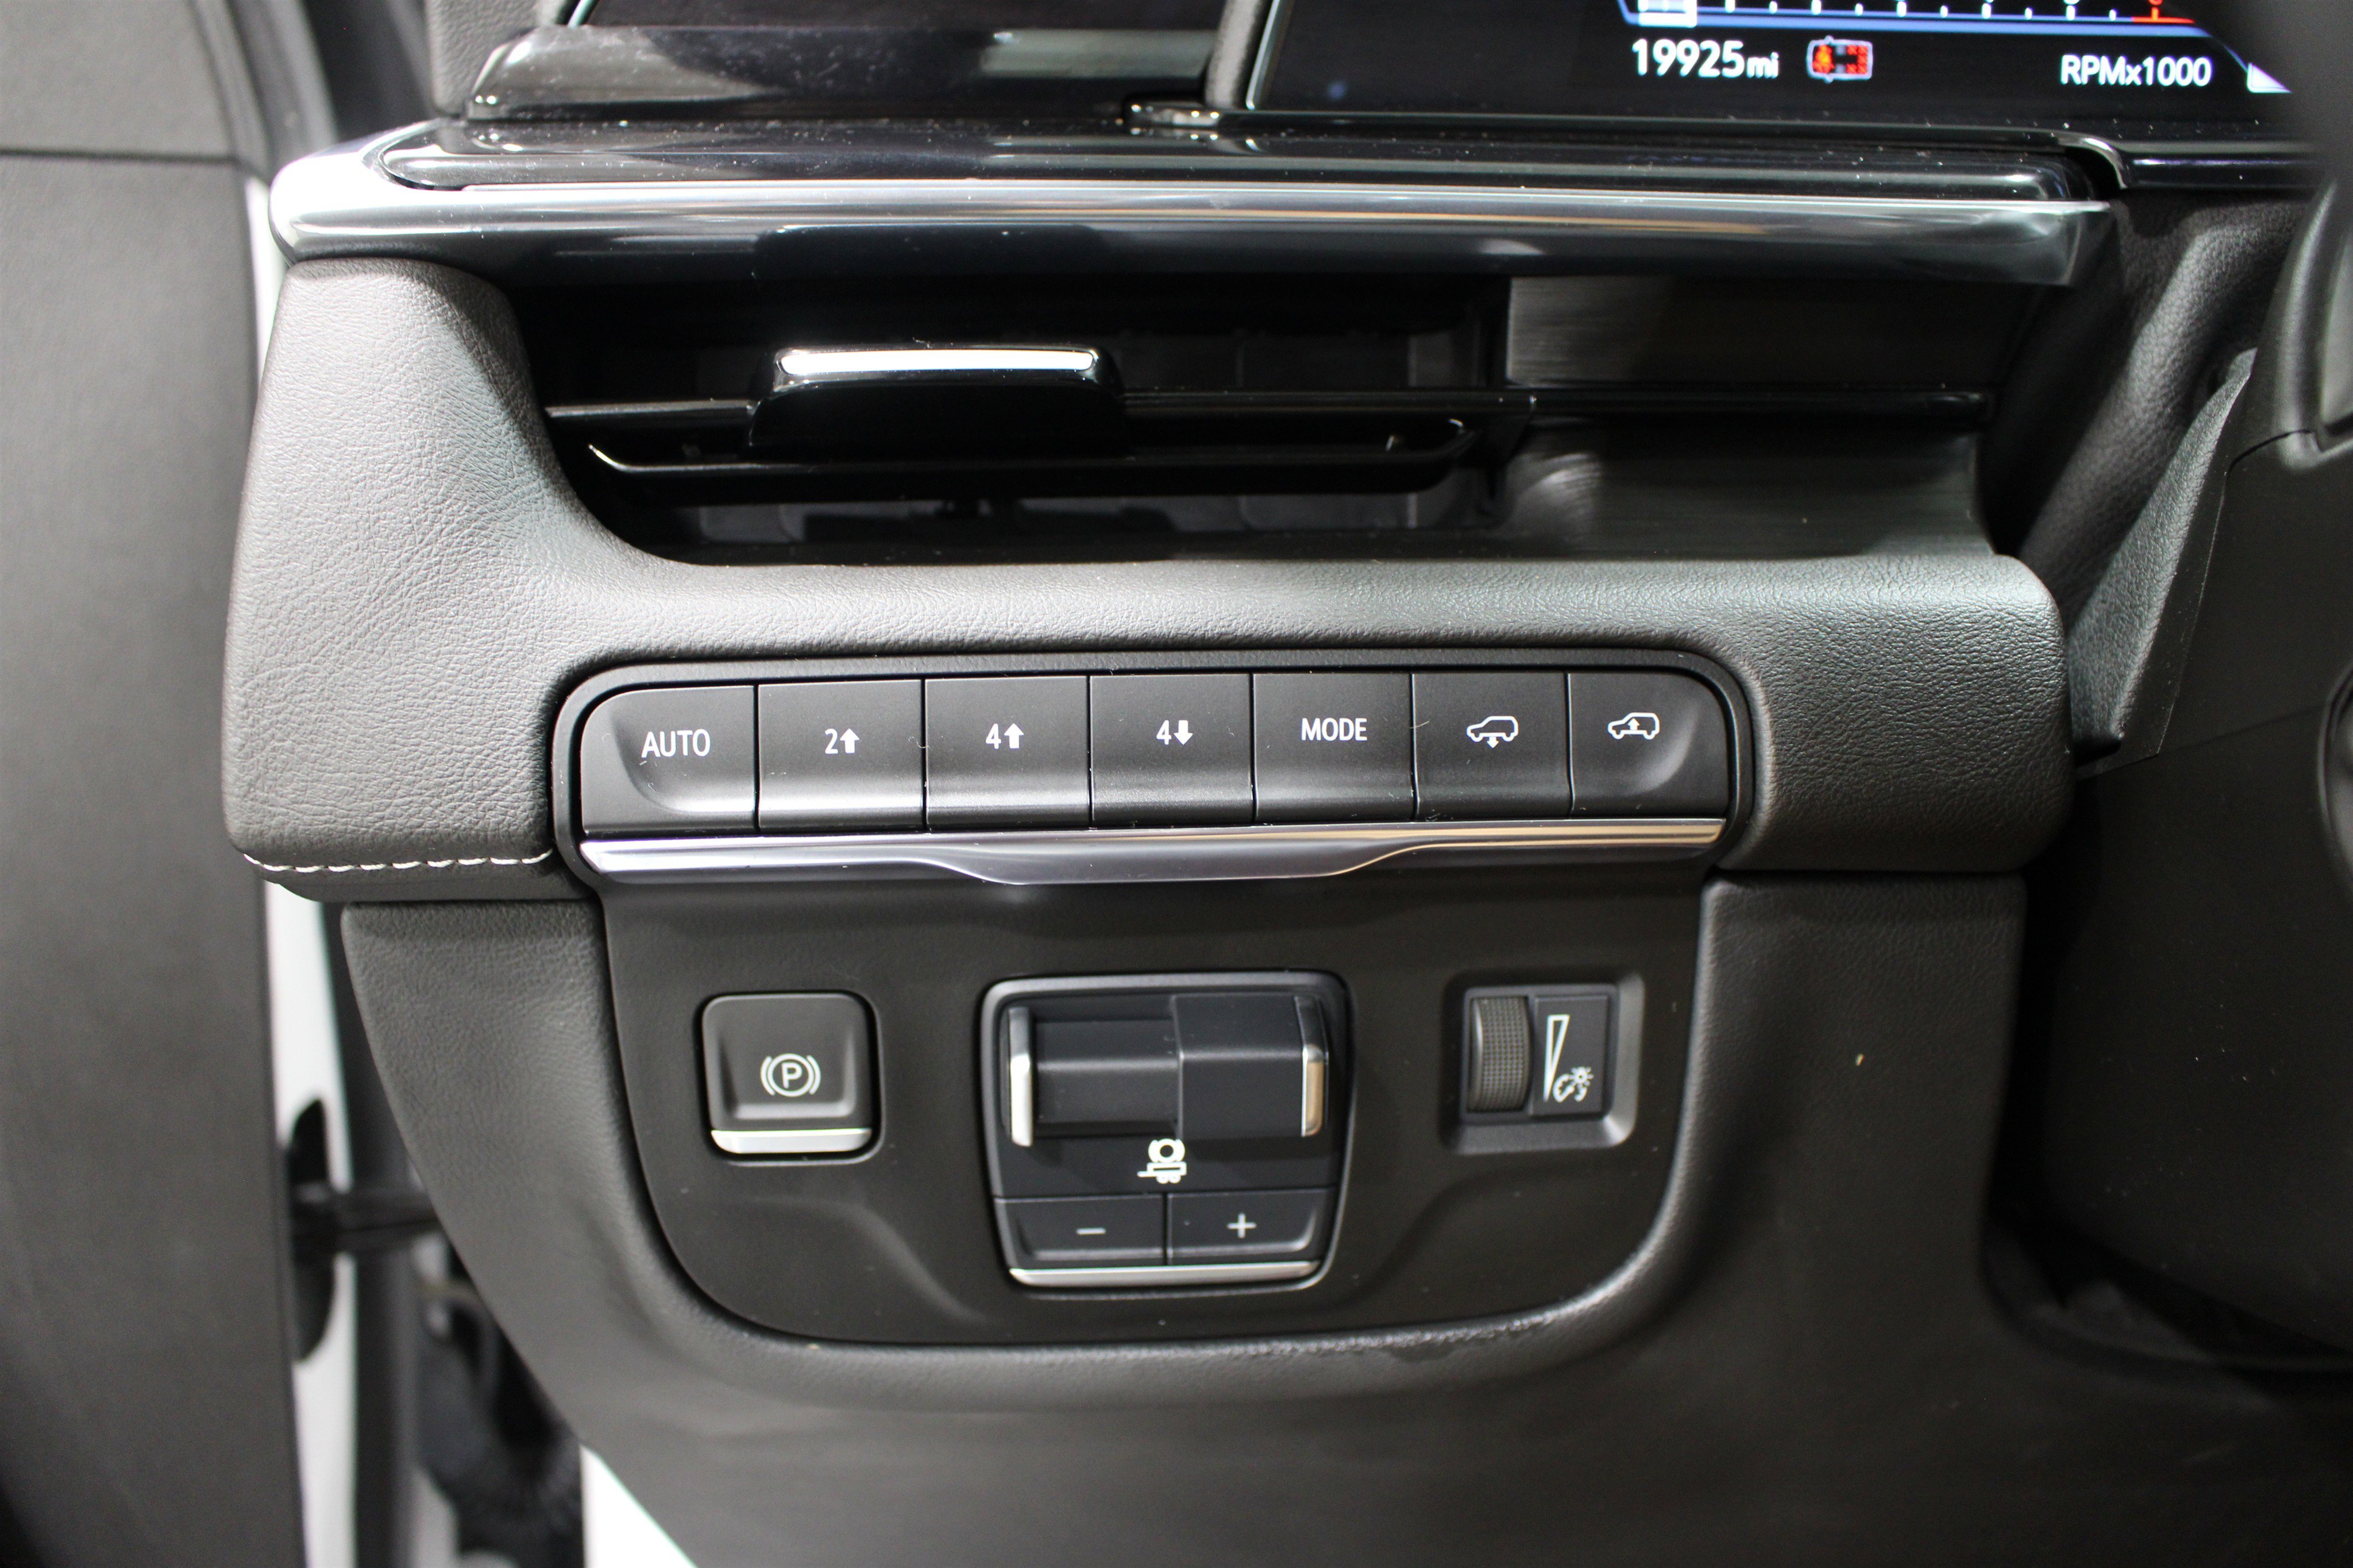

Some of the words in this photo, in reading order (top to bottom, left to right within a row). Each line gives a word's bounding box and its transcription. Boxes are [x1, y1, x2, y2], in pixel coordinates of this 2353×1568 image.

[1631, 38, 1779, 79] 19925mi
[2060, 54, 2212, 87] RPMx1000
[641, 728, 711, 758] AUTO
[1301, 717, 1367, 741] MODE
[781, 1062, 803, 1089] P
